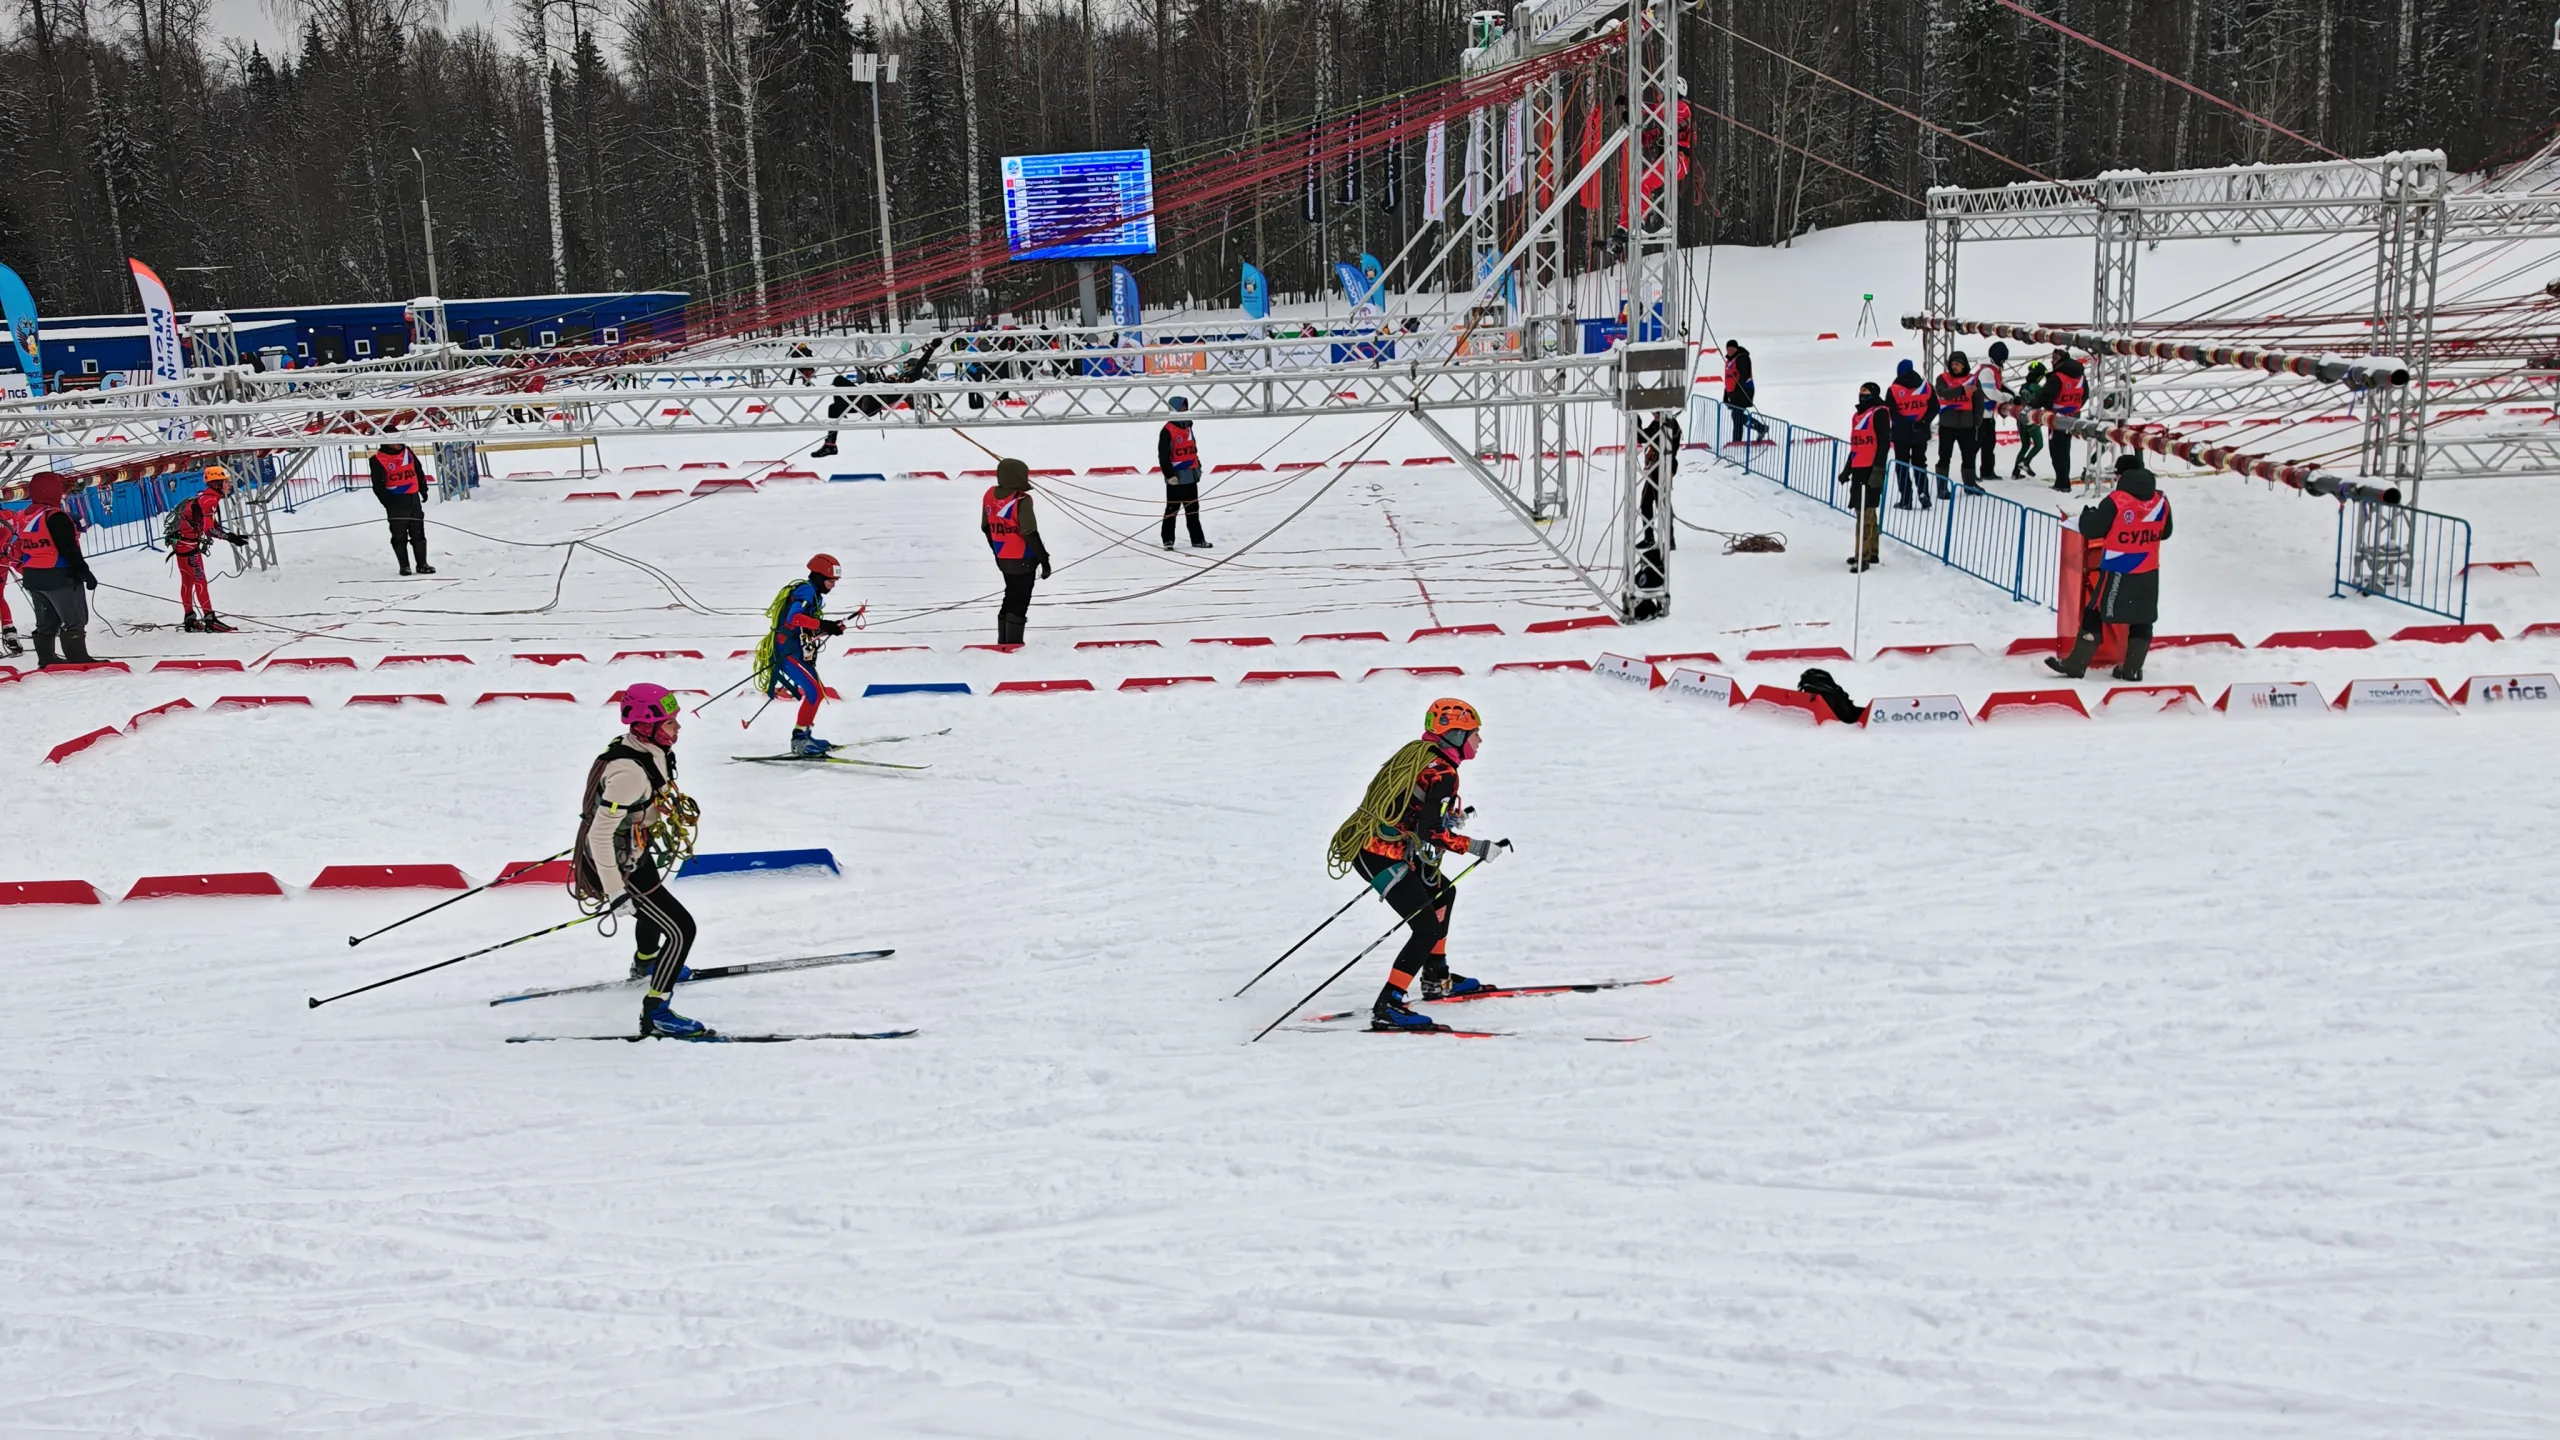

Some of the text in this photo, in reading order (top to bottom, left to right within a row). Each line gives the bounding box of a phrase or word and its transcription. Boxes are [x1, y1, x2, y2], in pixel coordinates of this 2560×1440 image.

[8, 389, 28, 399] ПСБ
[1851, 435, 1874, 446] ДЬЯ
[2508, 681, 2548, 700] ПСБ
